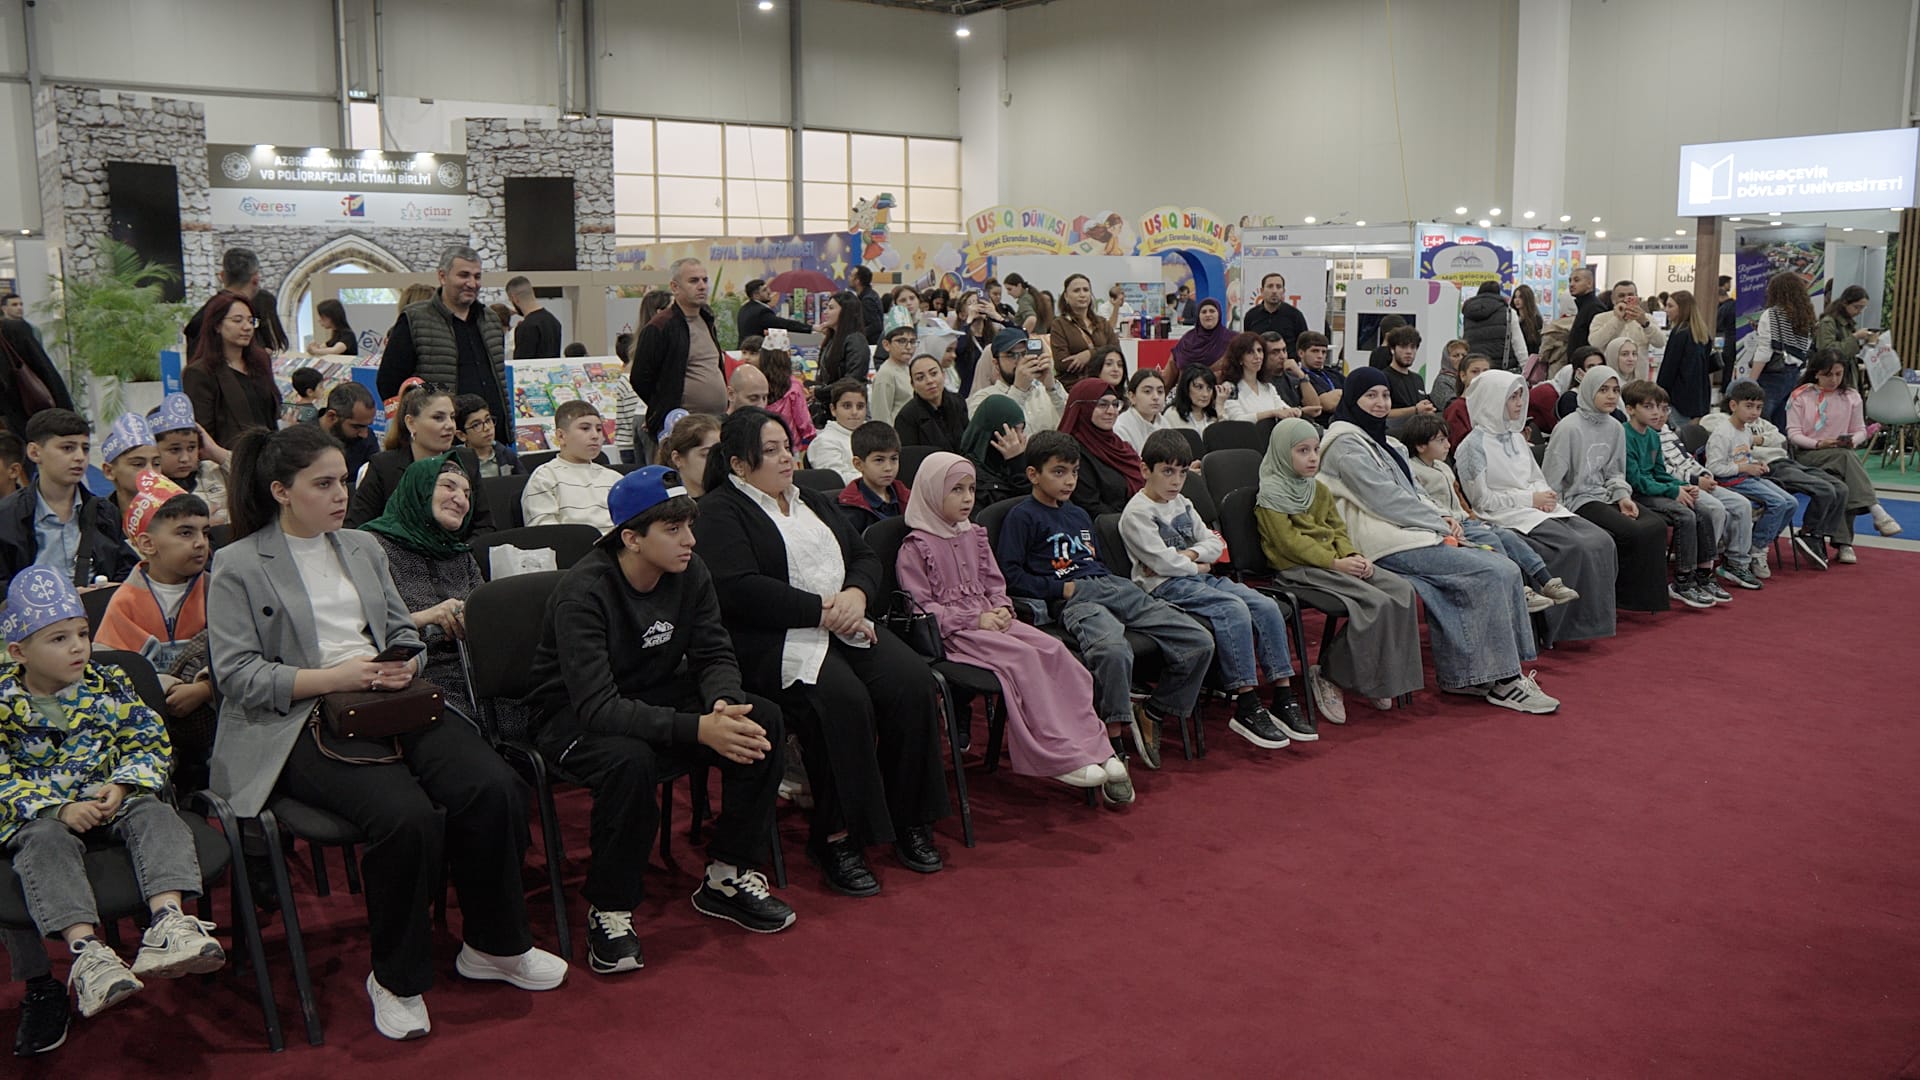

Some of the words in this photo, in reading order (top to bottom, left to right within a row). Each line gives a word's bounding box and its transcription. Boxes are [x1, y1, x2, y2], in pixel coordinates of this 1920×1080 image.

[259, 169, 275, 180] VƏ
[277, 168, 357, 184] POLİQRAFÇILAR
[358, 170, 397, 184] İCTİMAİ
[398, 172, 432, 185] BİRLİYİ
[1738, 165, 1829, 183] MİNGƏÇEVİR
[1737, 184, 1797, 199] DÖVLƏT
[1799, 176, 1904, 195] UNİVERSİTETİ
[976, 210, 1014, 234] UŞAQ
[1022, 210, 1067, 237] DÜNYASI
[1144, 212, 1178, 236] UŞAQ
[1183, 213, 1224, 240] DÜNYASI
[1667, 273, 1696, 283] Club
[1365, 283, 1409, 296] artistan
[1375, 296, 1398, 308] kids
